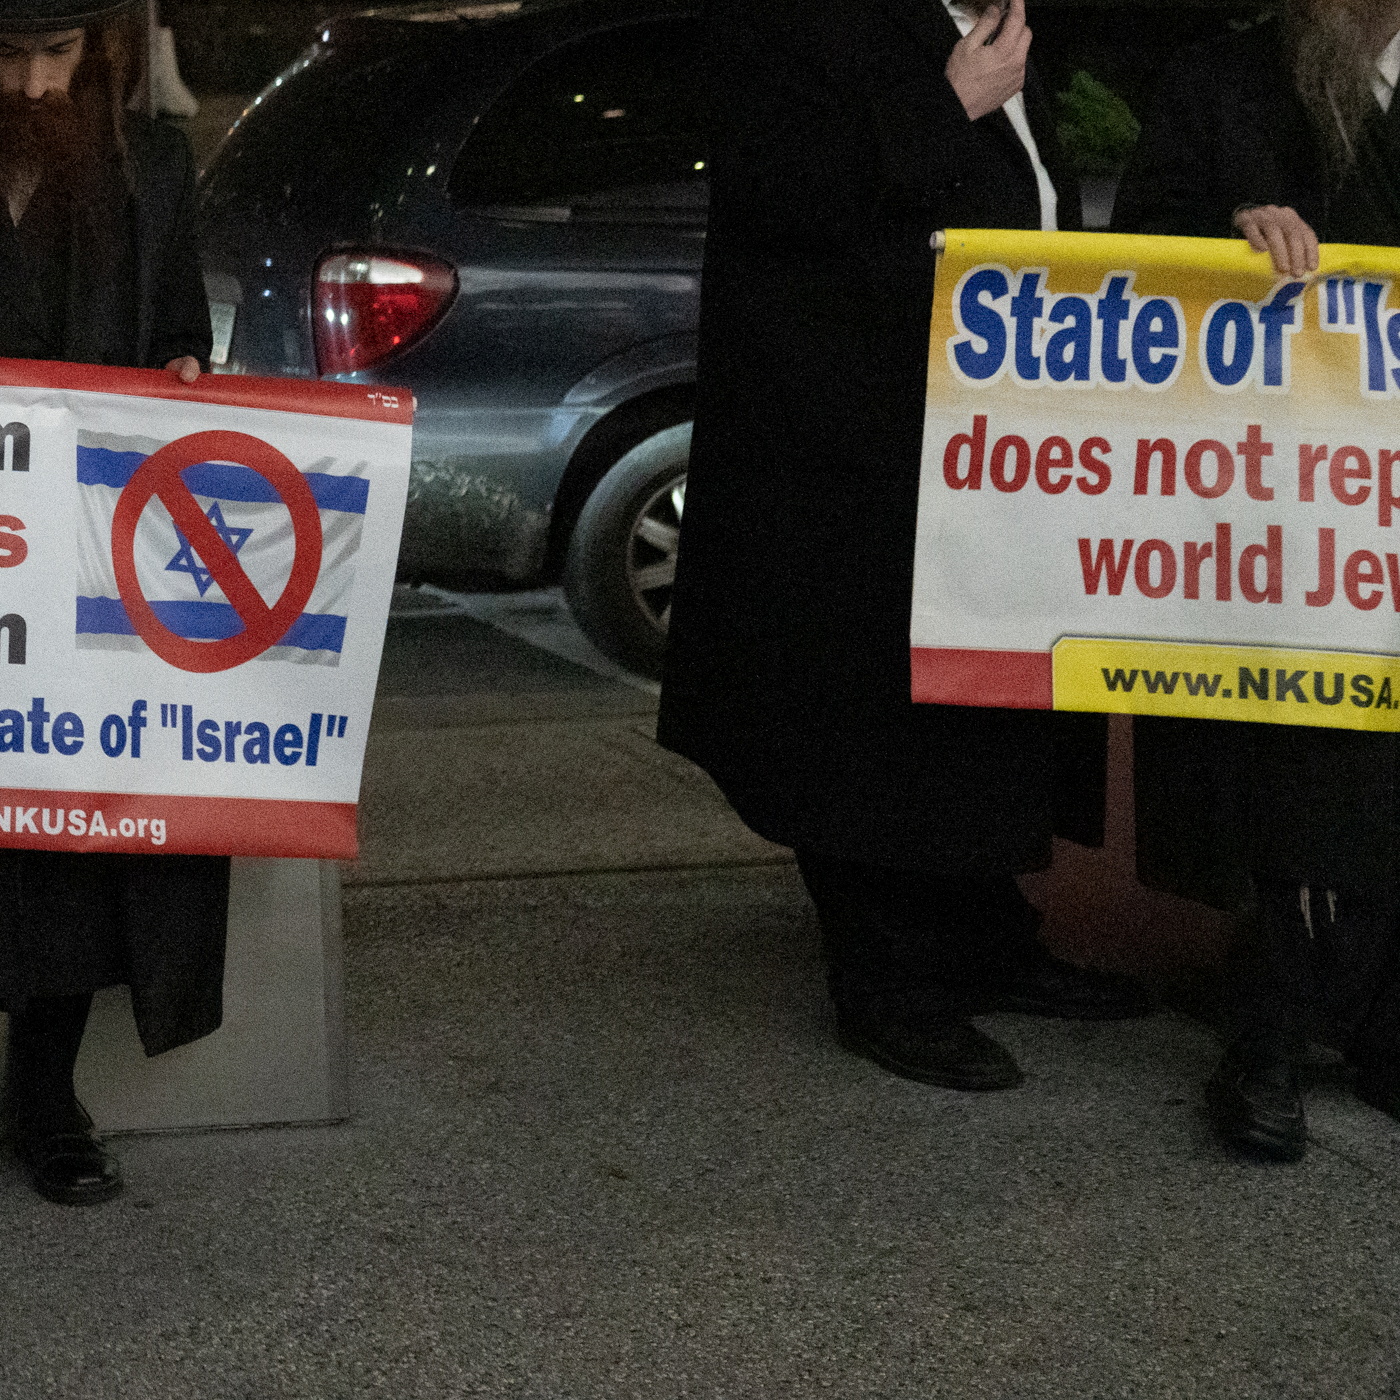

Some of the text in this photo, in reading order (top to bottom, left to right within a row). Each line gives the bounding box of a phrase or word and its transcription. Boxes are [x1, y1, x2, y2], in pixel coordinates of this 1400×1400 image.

[953, 269, 1179, 384] State
[1207, 281, 1306, 386] of
[943, 414, 1111, 495] does
[1133, 424, 1275, 501] not
[1078, 523, 1282, 604] world
[100, 699, 147, 759] of
[161, 703, 348, 767] "Israel"
